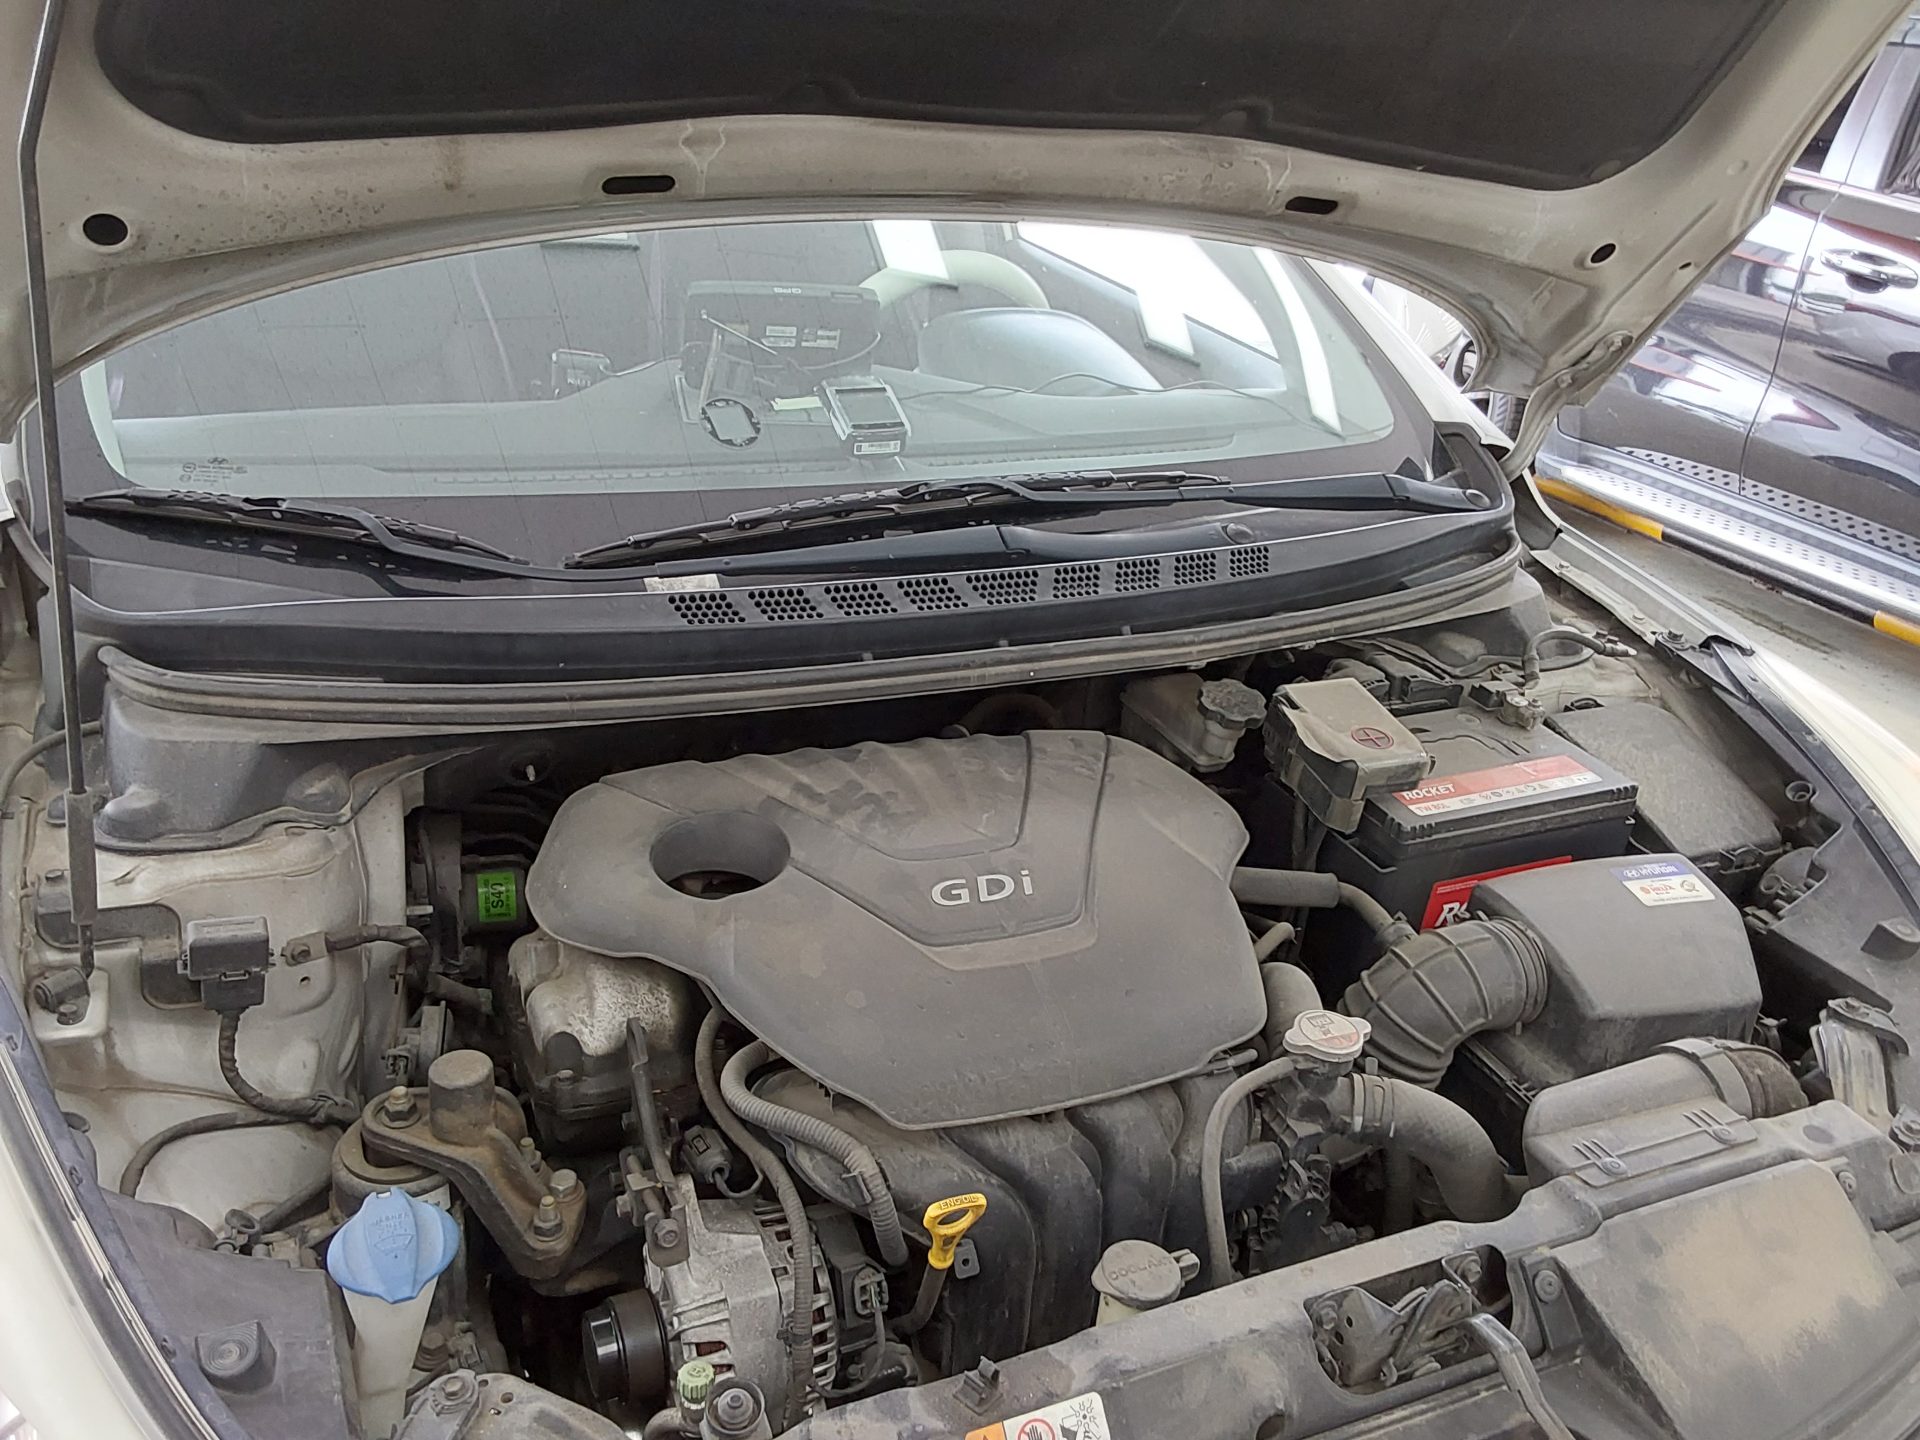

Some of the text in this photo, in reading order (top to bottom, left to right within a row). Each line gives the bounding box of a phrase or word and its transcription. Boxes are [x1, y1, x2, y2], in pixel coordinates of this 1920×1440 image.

[1402, 784, 1456, 801] ROCKET
[931, 869, 1033, 906] GDi
[940, 1194, 978, 1209] ENG OIL
